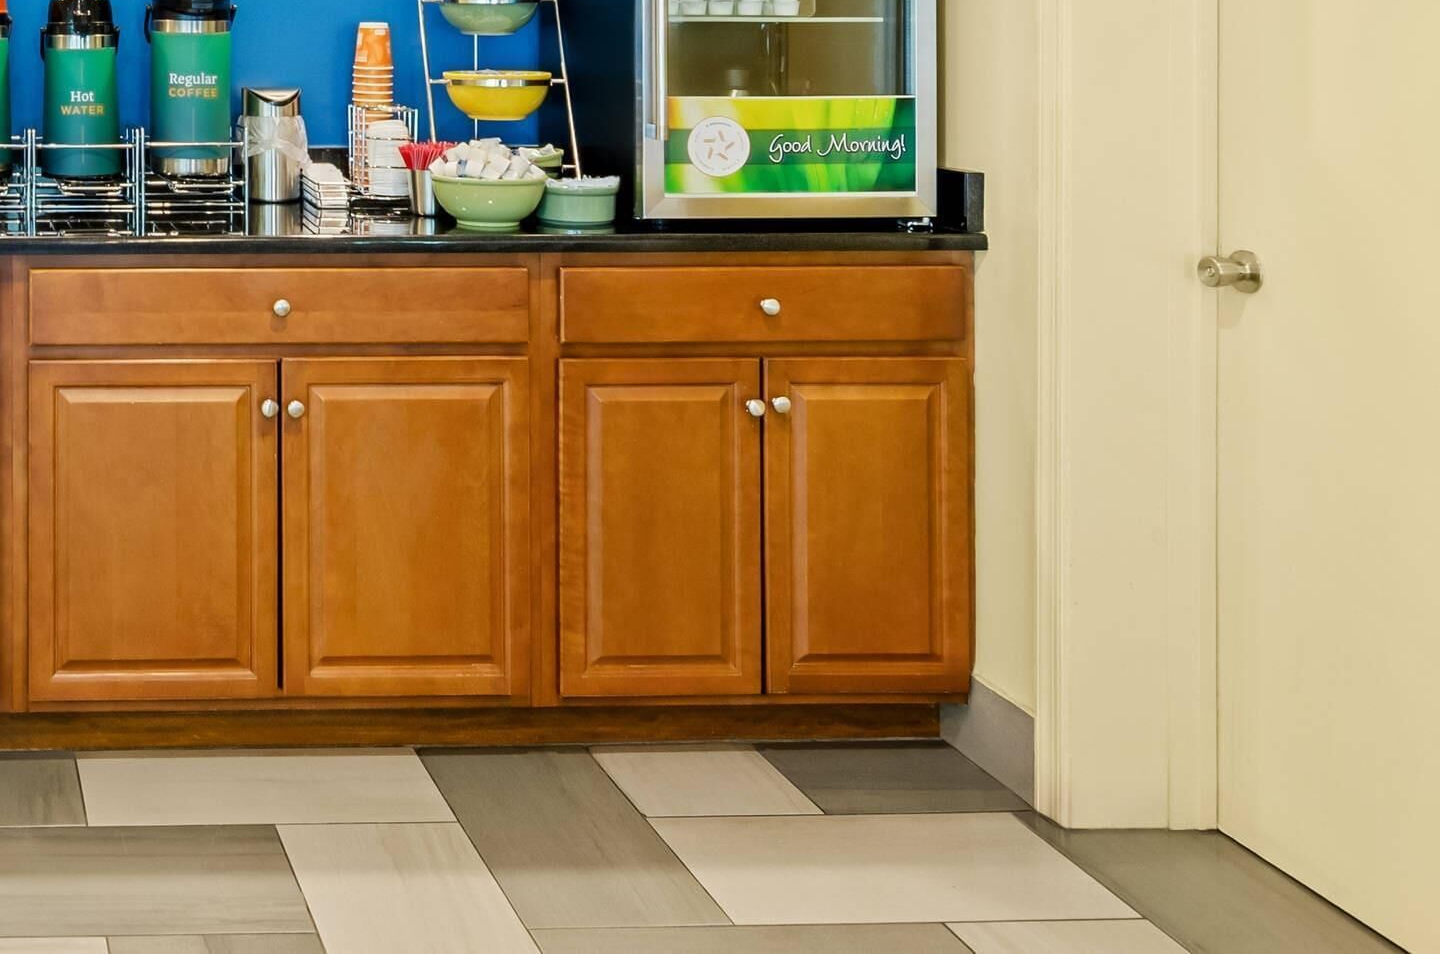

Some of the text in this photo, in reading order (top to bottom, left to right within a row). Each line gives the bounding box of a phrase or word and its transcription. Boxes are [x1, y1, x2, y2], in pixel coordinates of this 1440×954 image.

[168, 72, 218, 87] Regular
[70, 90, 95, 102] Hot
[168, 87, 218, 98] COFFEE
[60, 105, 105, 116] WATER
[768, 133, 907, 163] Good Morning!
